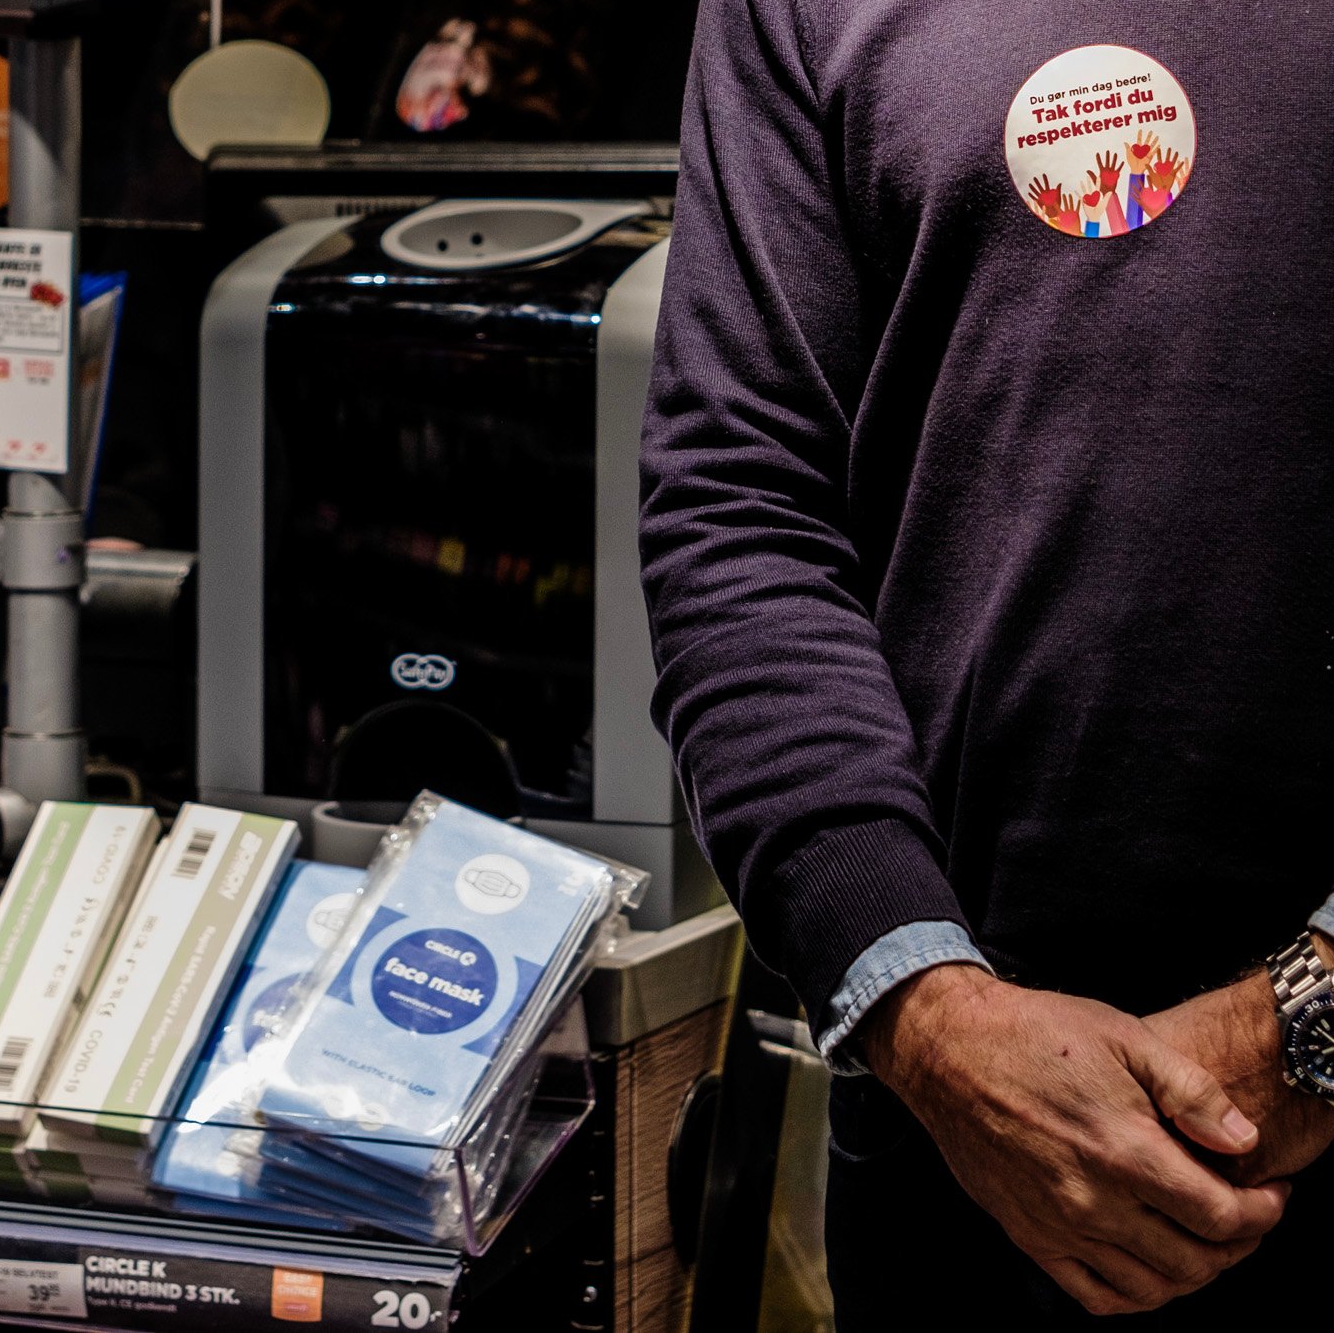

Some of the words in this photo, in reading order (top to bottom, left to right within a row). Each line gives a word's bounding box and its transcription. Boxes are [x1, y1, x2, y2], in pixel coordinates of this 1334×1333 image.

[1029, 95, 1045, 105] Du
[1047, 90, 1066, 104] gør
[1069, 86, 1089, 98] min
[1091, 81, 1113, 94] dag
[1115, 73, 1152, 89] bedre!
[1032, 104, 1070, 124] Tak
[1073, 92, 1123, 116] fordi
[1127, 88, 1154, 106] du
[1017, 113, 1133, 149] respekterer
[1137, 104, 1177, 125] mig
[425, 939, 459, 962] CIRCLE
[384, 956, 429, 987] face
[427, 974, 485, 1007] mask
[1304, 1000, 1320, 1014] 30
[64, 1029, 103, 1093] COVID-19
[408, 1081, 437, 1098] LOOP
[85, 1255, 149, 1277] CIRCLE
[150, 1260, 168, 1279] K
[86, 1275, 183, 1302] MUNDBIND
[185, 1283, 199, 1302] 3
[199, 1285, 241, 1306] STK.
